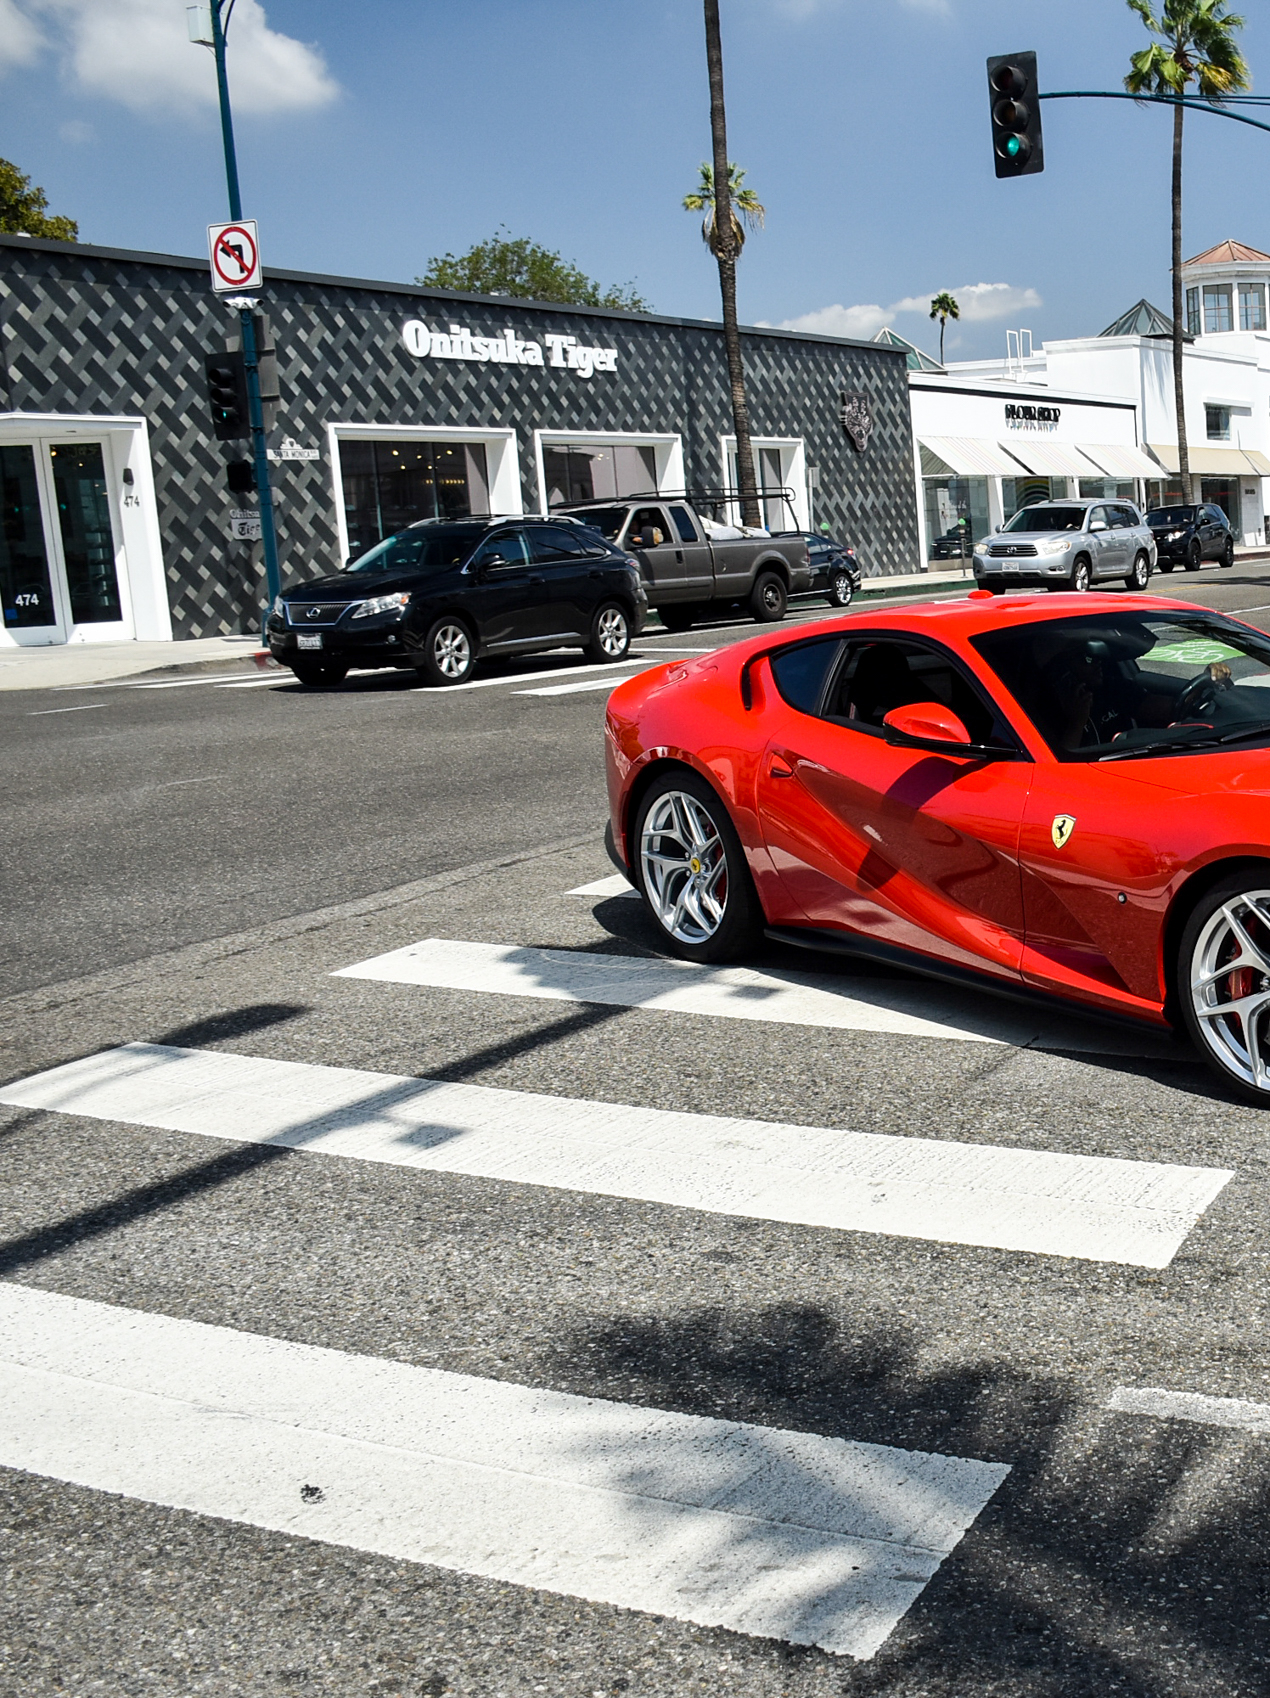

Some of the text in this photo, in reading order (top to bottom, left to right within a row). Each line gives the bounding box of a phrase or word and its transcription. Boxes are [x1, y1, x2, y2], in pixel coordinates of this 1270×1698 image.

[402, 319, 618, 379] Onitsuka Tiger
[124, 496, 140, 507] 474
[15, 593, 39, 606] 474
